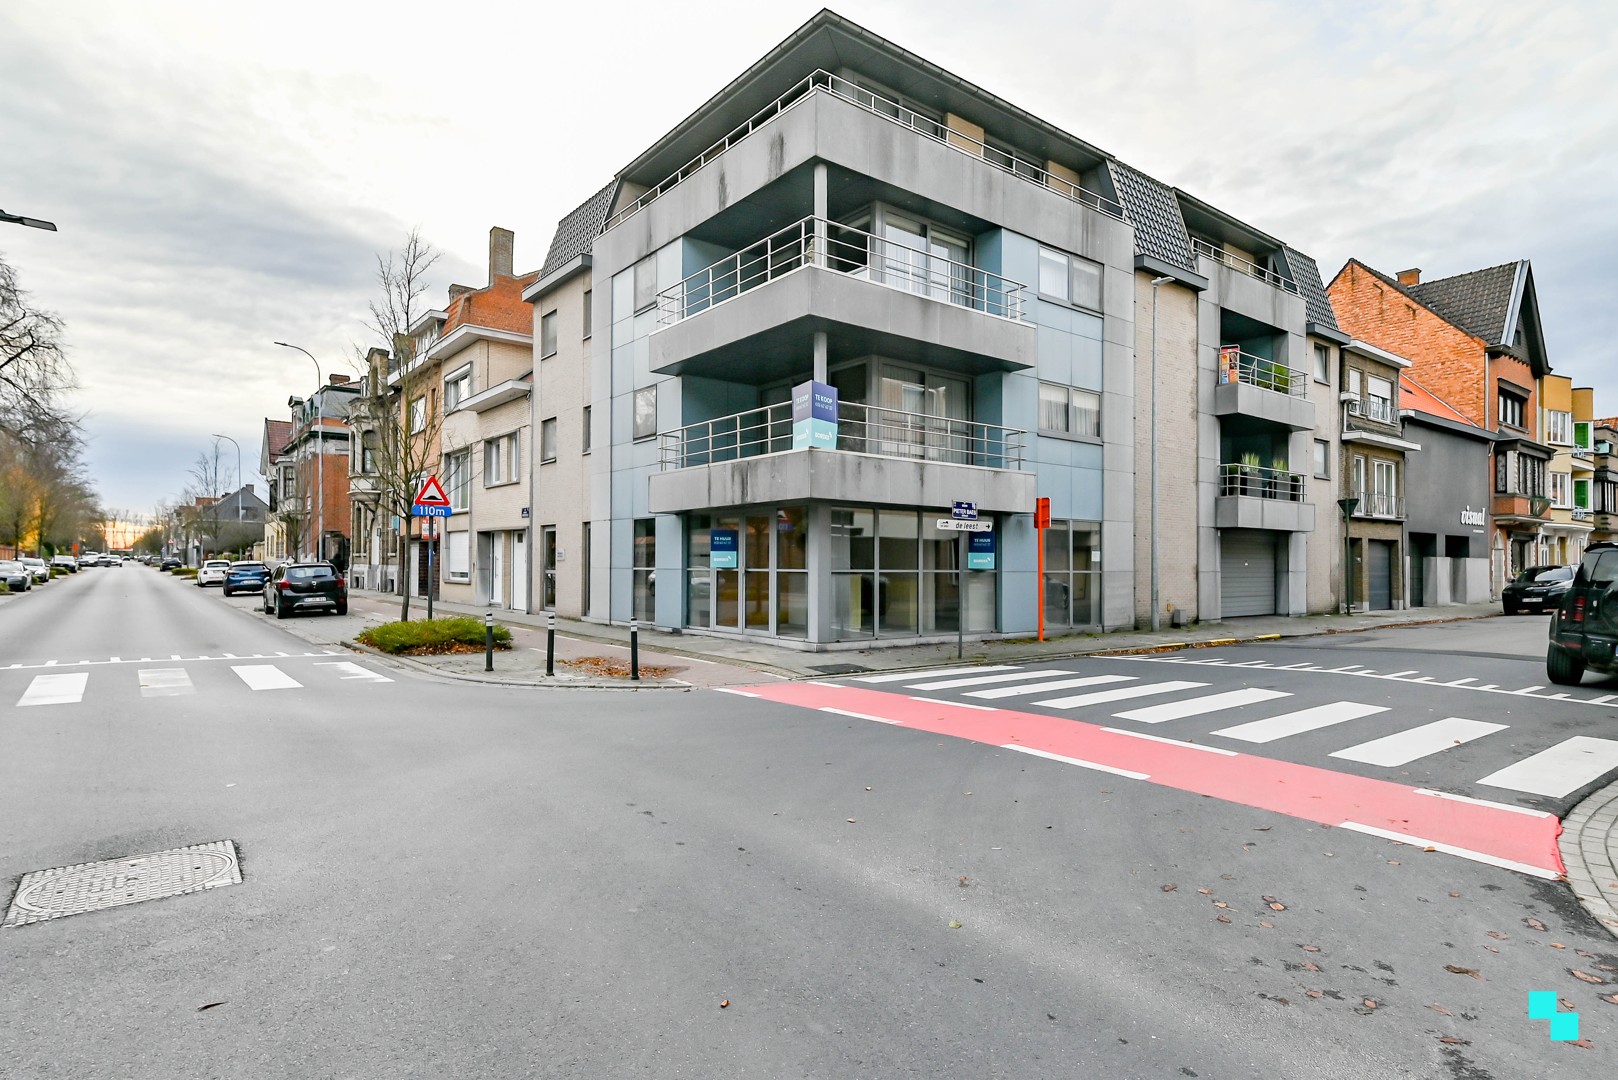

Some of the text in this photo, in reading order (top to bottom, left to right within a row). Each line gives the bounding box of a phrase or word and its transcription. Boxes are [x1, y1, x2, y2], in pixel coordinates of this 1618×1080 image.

[821, 396, 833, 404] KOOP
[420, 506, 445, 516] 110m
[1461, 505, 1485, 526] visual
[963, 522, 979, 530] leest
